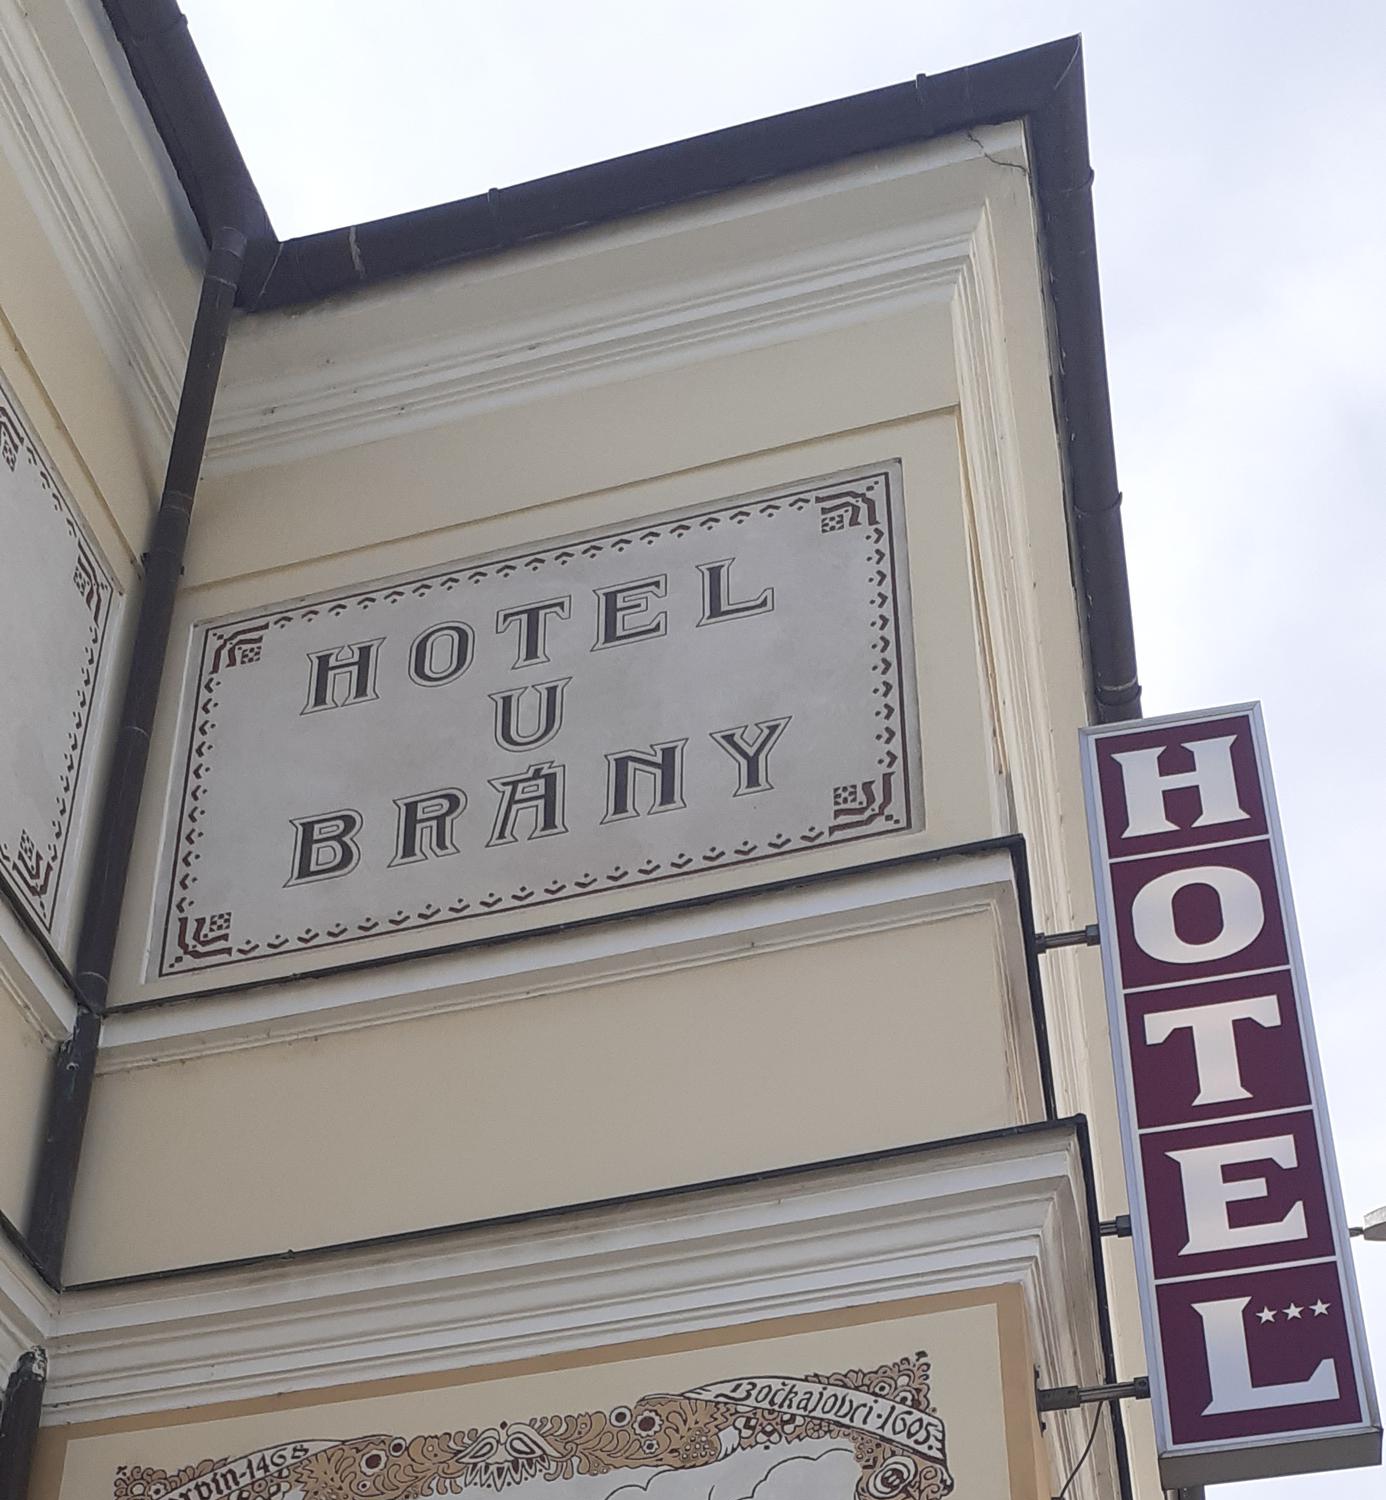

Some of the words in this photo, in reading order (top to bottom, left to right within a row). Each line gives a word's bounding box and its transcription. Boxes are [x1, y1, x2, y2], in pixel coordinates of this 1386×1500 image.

[300, 557, 775, 715] HOTEL
[488, 677, 573, 752] U
[282, 716, 793, 888] BRÁNY
[1110, 734, 1340, 1416] HOTEL
